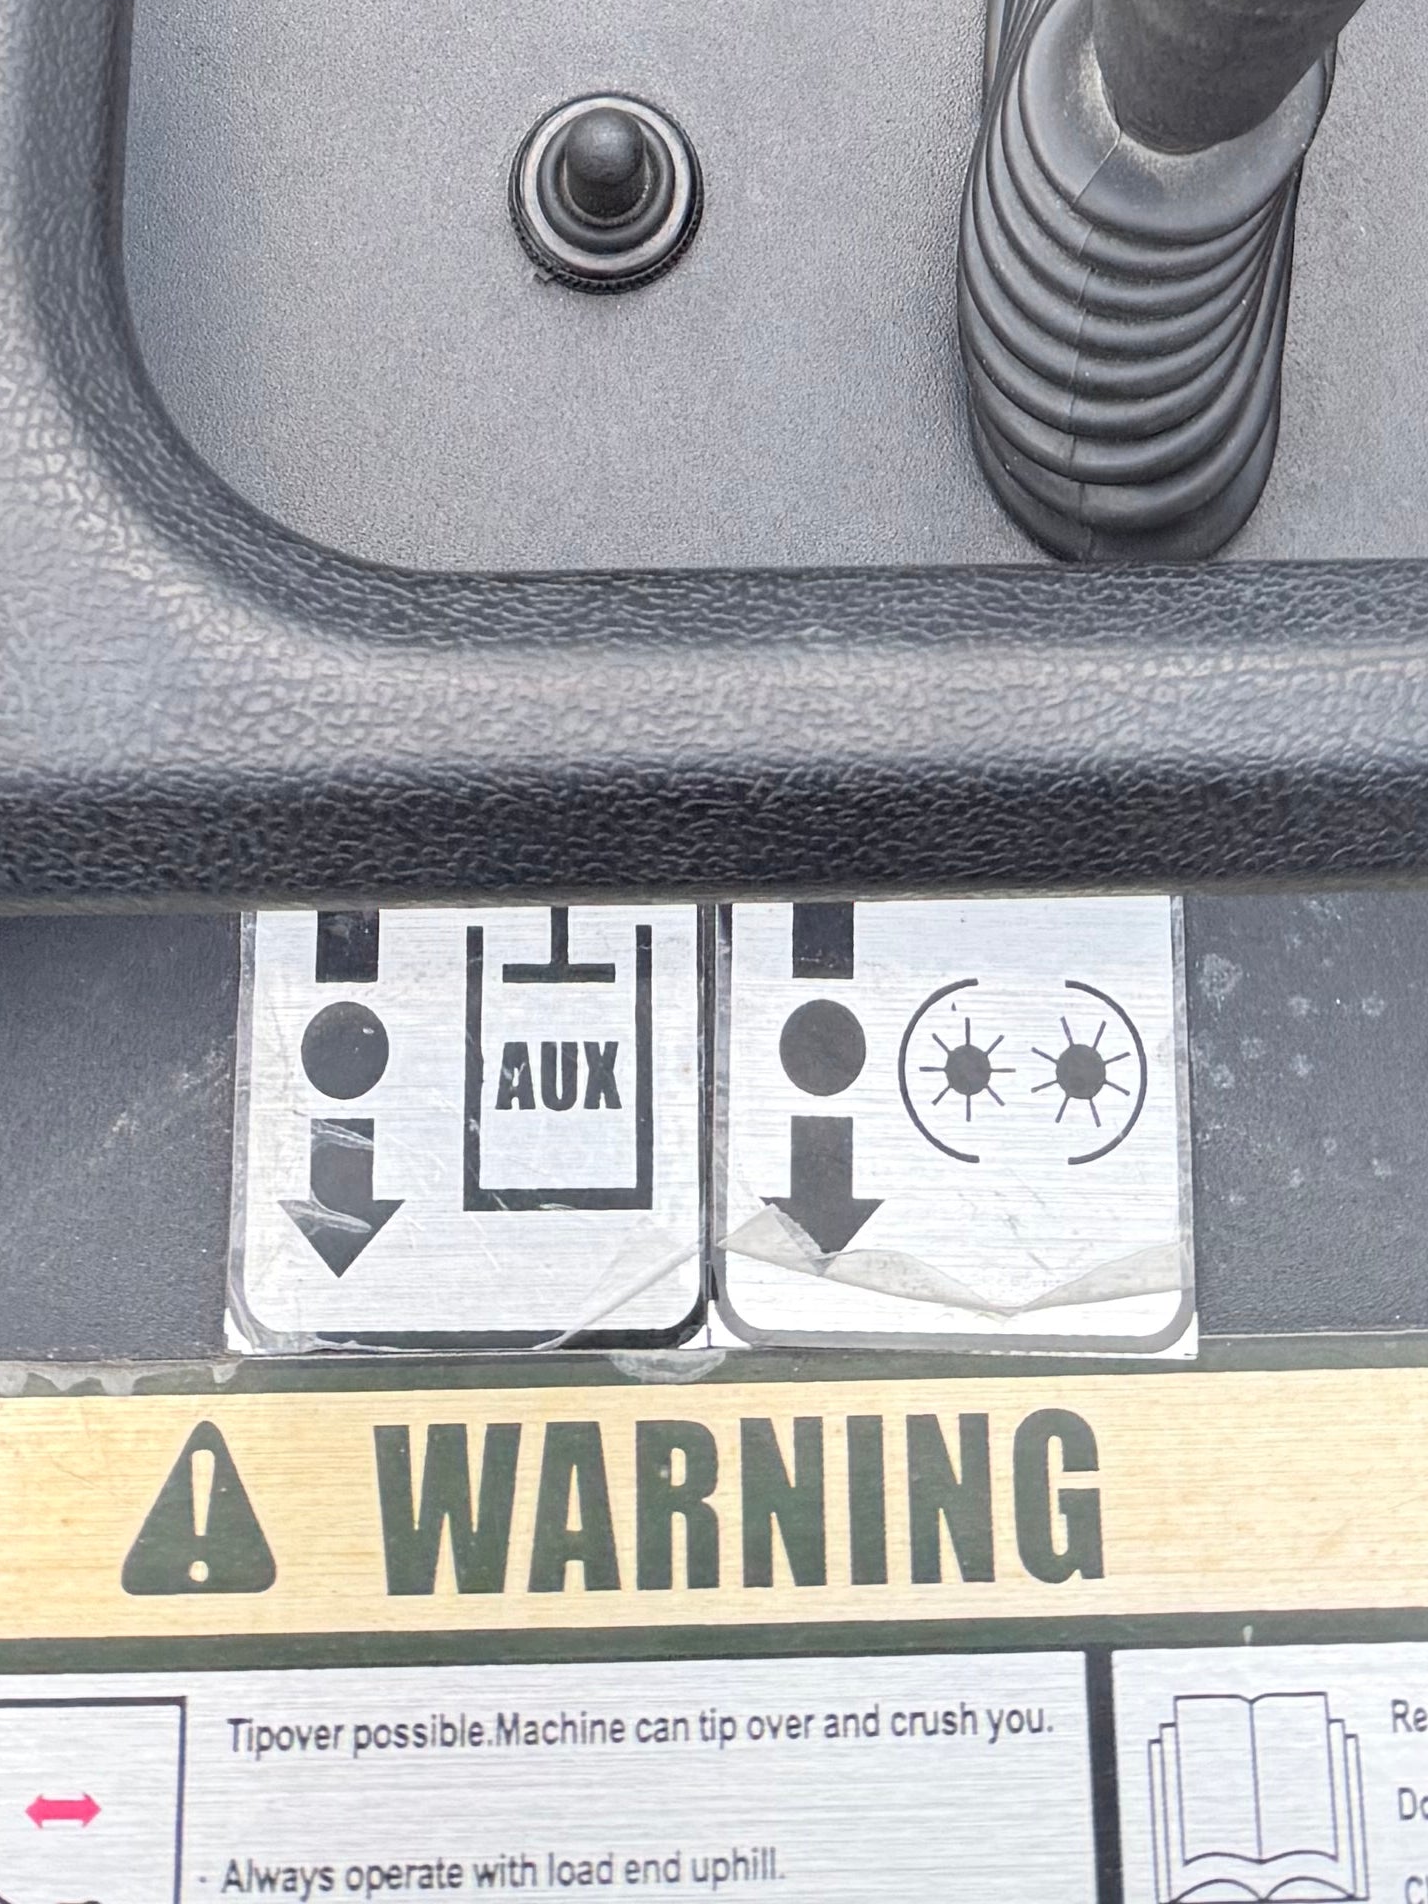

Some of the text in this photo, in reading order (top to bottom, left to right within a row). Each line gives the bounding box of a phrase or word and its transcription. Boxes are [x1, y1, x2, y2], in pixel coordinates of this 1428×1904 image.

[494, 1040, 622, 1112] AUX
[372, 1407, 1106, 1596] WARNING
[227, 1717, 344, 1761] Tipover
[635, 1716, 690, 1743] can
[699, 1708, 737, 1750] tip
[746, 1712, 815, 1740] over
[823, 1704, 881, 1738] and
[890, 1701, 978, 1737] crush
[986, 1706, 1054, 1744] you.
[220, 1846, 786, 1903] Always operate with load end uphill.
